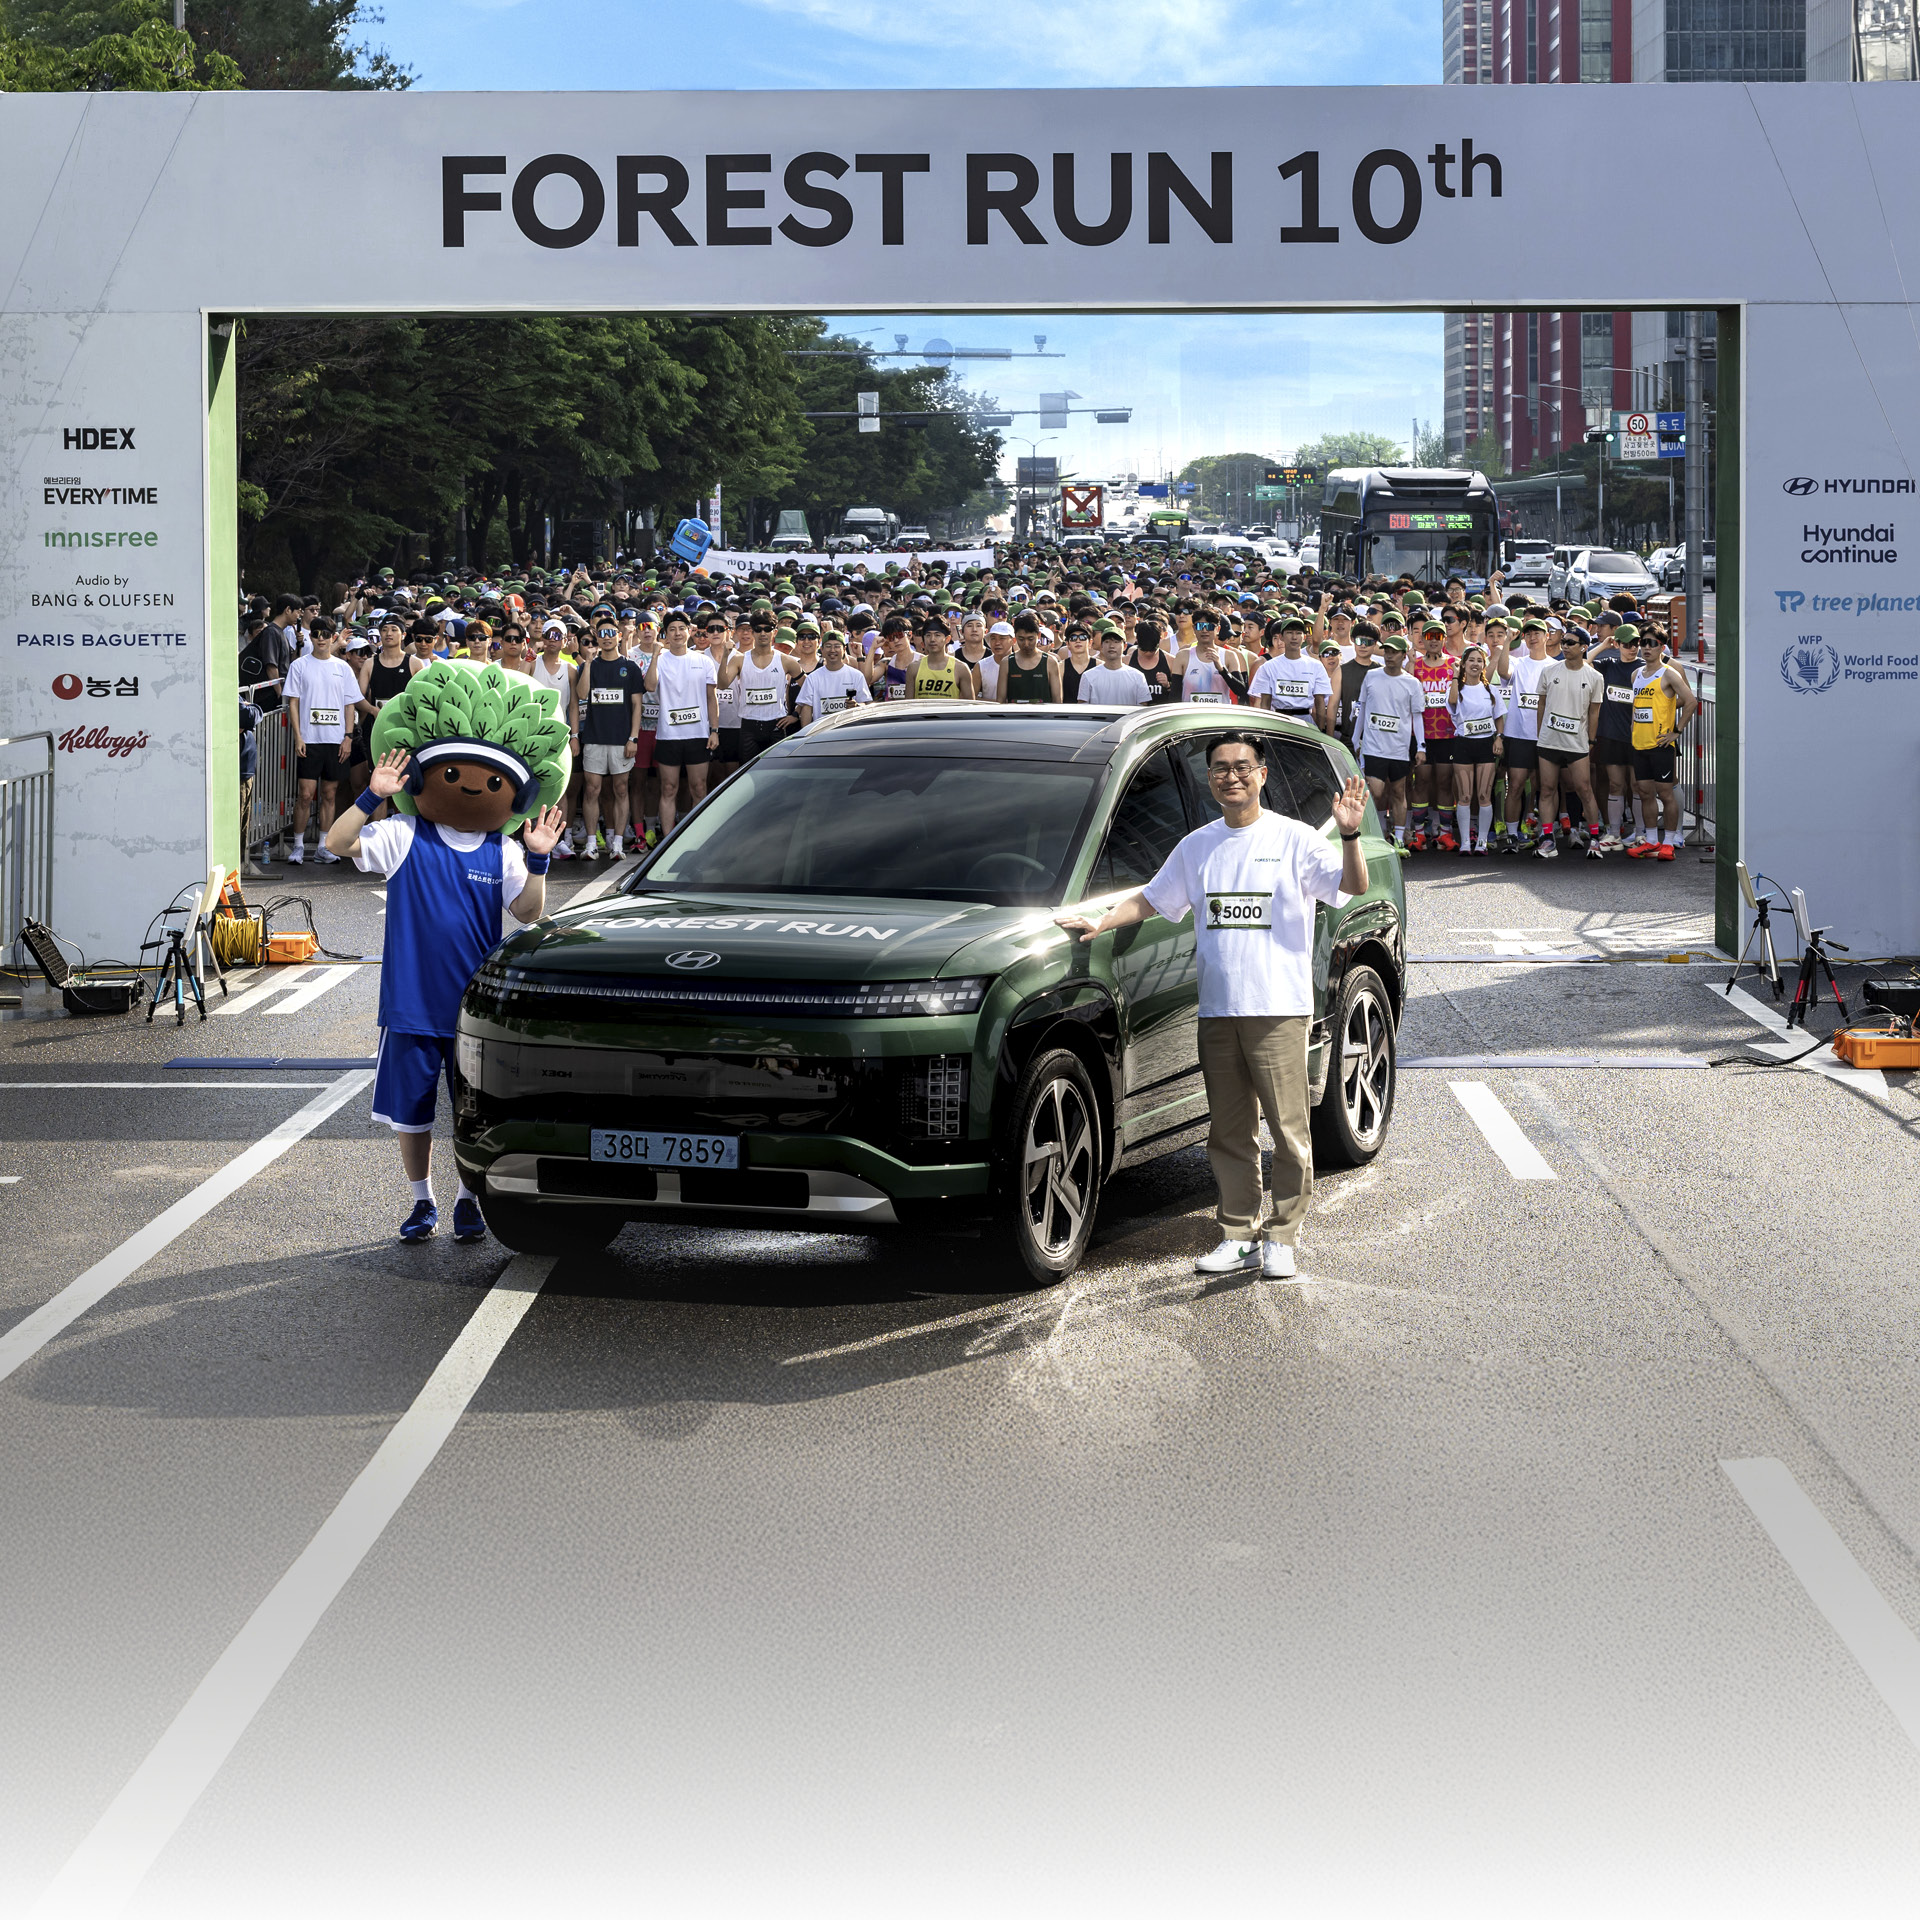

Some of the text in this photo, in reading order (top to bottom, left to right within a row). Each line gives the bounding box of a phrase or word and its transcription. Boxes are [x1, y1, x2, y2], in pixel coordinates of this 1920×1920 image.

[442, 138, 1503, 248] FOREST RUN 10th
[1632, 419, 1644, 430] 50
[1659, 418, 1685, 431] 속도
[63, 428, 136, 450] HDEX
[43, 476, 81, 486] 에브리타임
[1824, 478, 1916, 494] HYUNDAI
[1390, 513, 1411, 529] 600
[1803, 523, 1895, 546] Hyundai
[1800, 544, 1898, 564] continue
[75, 574, 129, 589] Audio by
[31, 593, 174, 607] BANG & OLUFSEN
[1812, 594, 1853, 612] tree
[1857, 592, 1920, 617] planet
[16, 633, 187, 647] PARIS BAGUETTE
[1797, 635, 1823, 645] WFP
[1843, 654, 1919, 667] World Food
[1844, 669, 1919, 683] Programme
[86, 676, 140, 698] 농심
[918, 679, 953, 692] 1987
[754, 693, 773, 701] 1189
[1614, 691, 1631, 700] 1208
[678, 712, 697, 721] 1093
[1378, 719, 1396, 728] 1027
[58, 724, 150, 758] Kellogg's
[1223, 905, 1262, 919] 5000
[573, 917, 899, 940] FOREST RUN
[604, 1134, 725, 1164] 38다 7859
